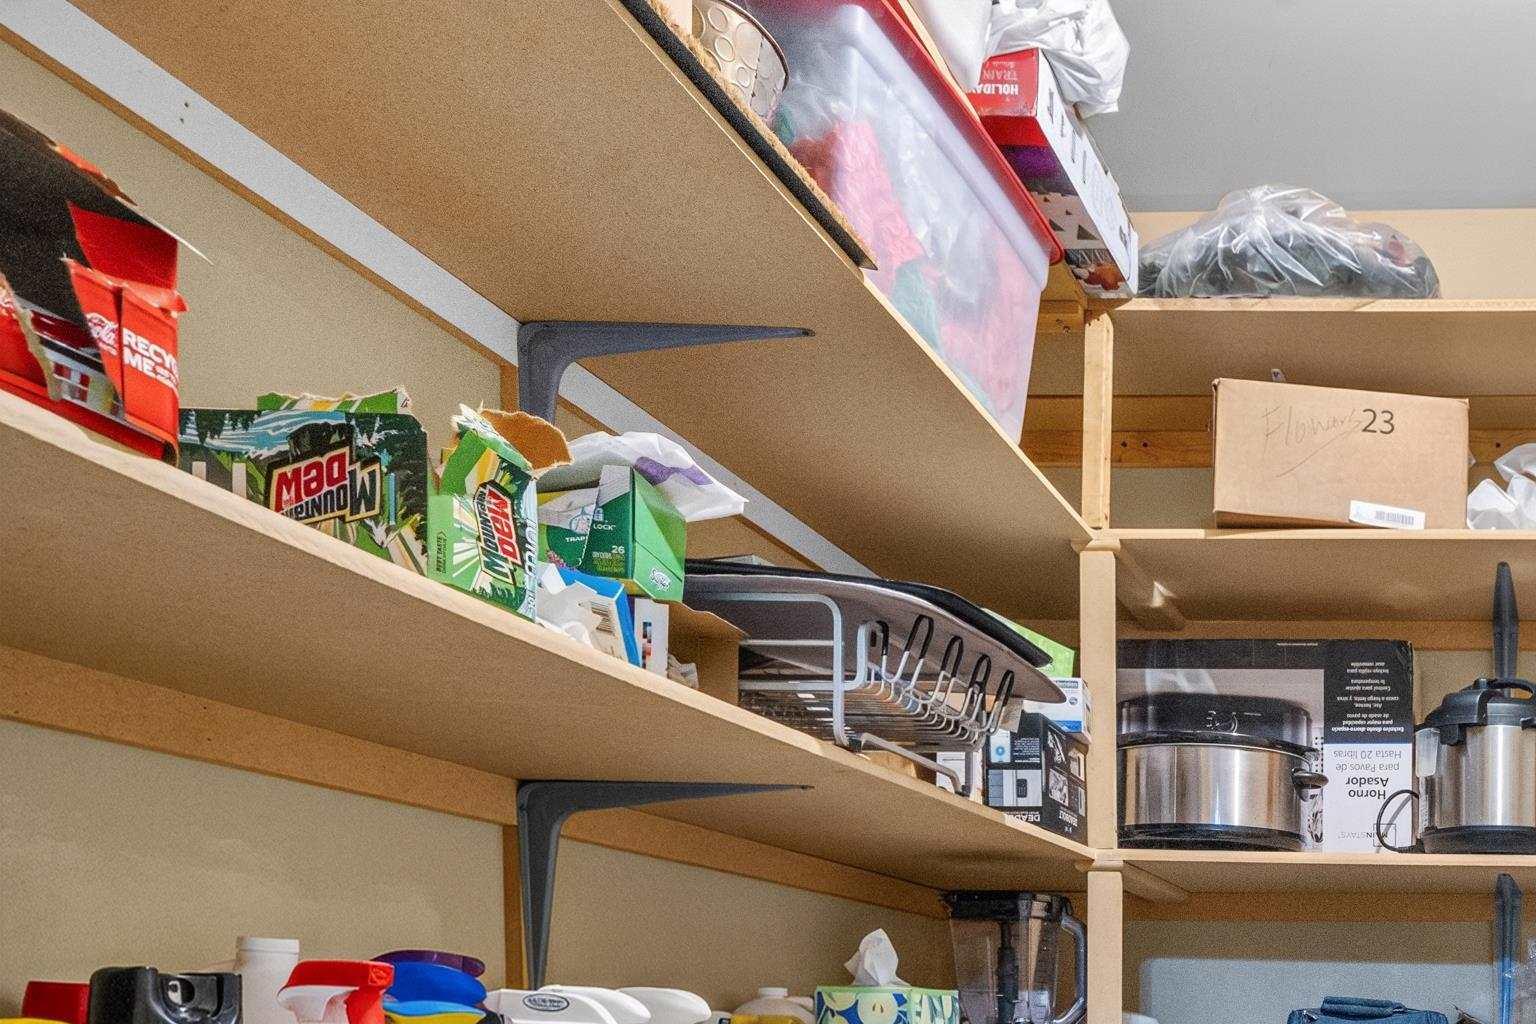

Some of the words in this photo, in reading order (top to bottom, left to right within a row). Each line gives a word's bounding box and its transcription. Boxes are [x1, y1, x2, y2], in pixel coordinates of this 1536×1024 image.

[122, 327, 179, 380] RECY
[1362, 408, 1395, 434] 23
[593, 523, 614, 531] LOCK
[611, 545, 626, 554] 26
[1333, 749, 1358, 759] libras
[1360, 750, 1372, 759] 20
[1375, 750, 1402, 759] Hasta
[1336, 763, 1349, 772] de
[1350, 763, 1377, 772] Pavos
[1379, 763, 1400, 771] para
[1345, 776, 1390, 788] Asador
[1348, 789, 1387, 800] Horno
